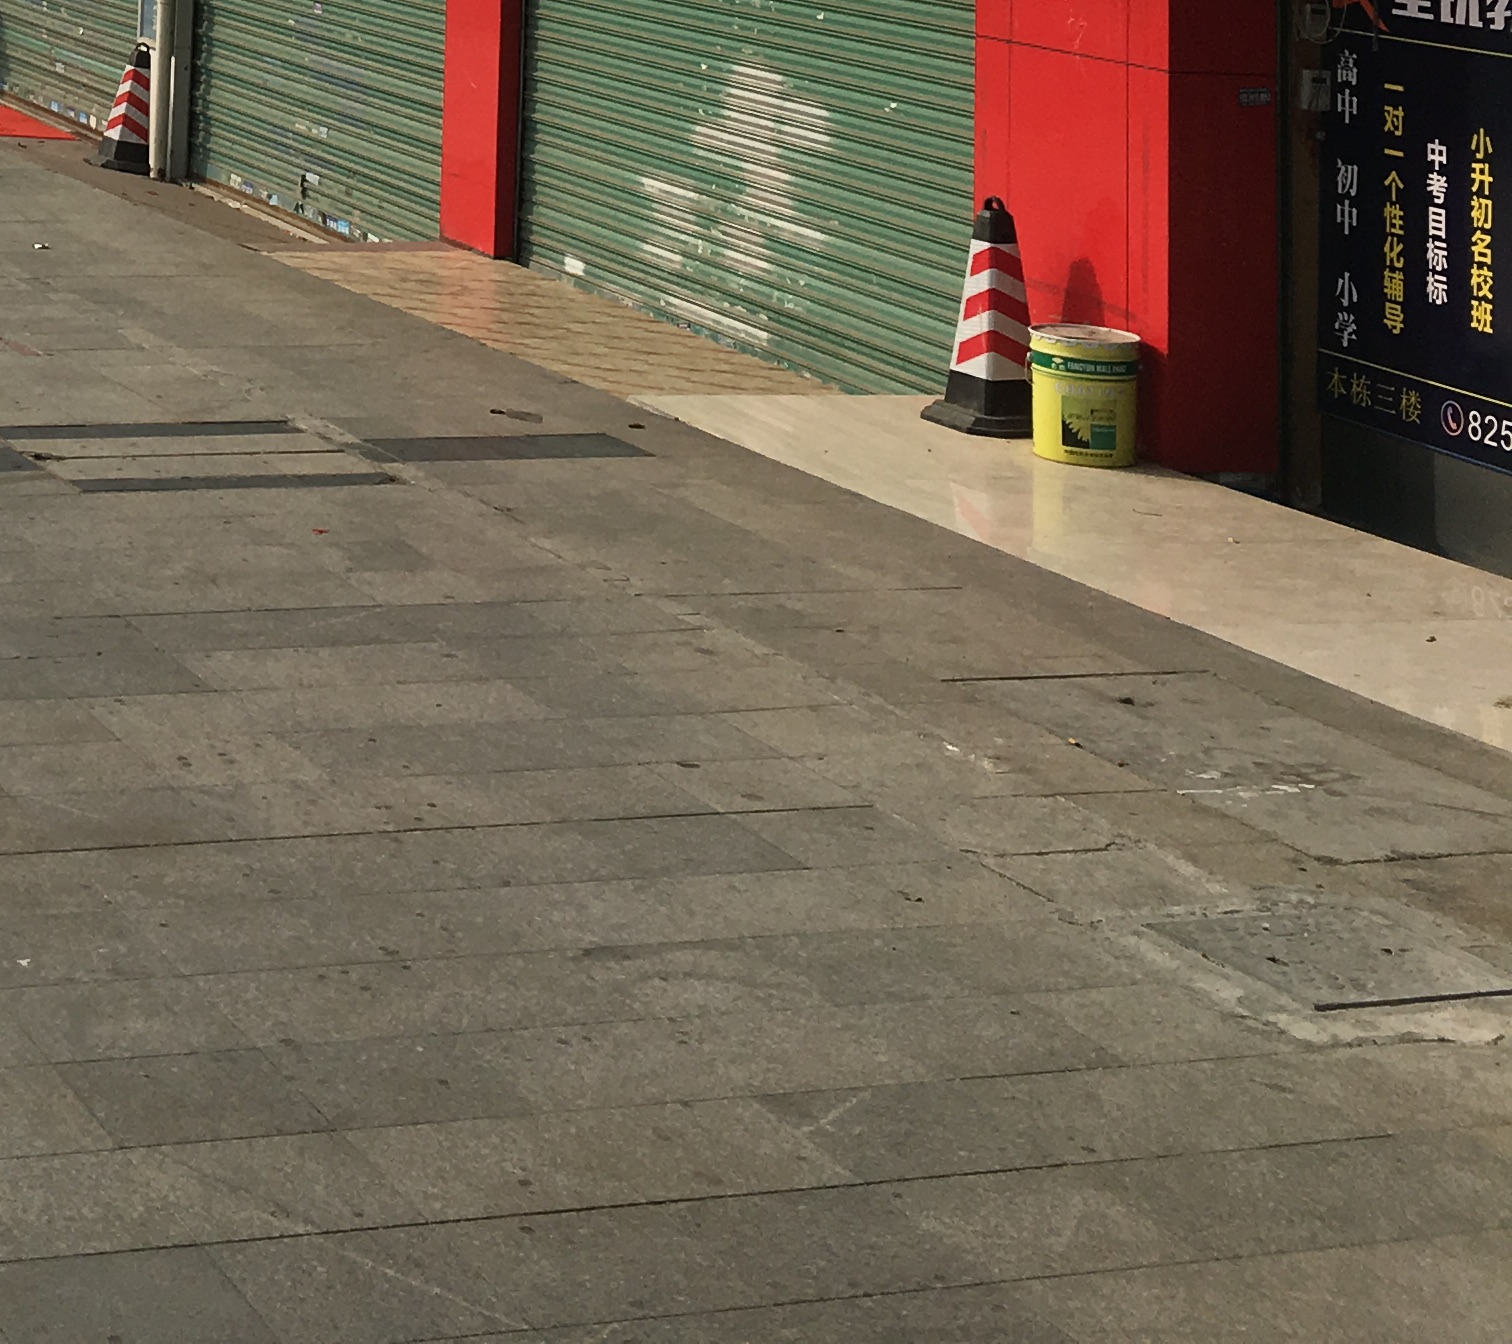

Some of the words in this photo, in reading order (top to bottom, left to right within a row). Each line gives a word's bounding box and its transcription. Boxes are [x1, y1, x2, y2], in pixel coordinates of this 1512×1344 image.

[1334, 48, 1358, 124] 高中
[1334, 157, 1358, 236] 初中
[1382, 81, 1405, 336] 一对一个性化辅导
[1470, 127, 1494, 334] 小升初名校班
[1333, 270, 1358, 349] 小学
[1325, 364, 1423, 425] 本栋三楼
